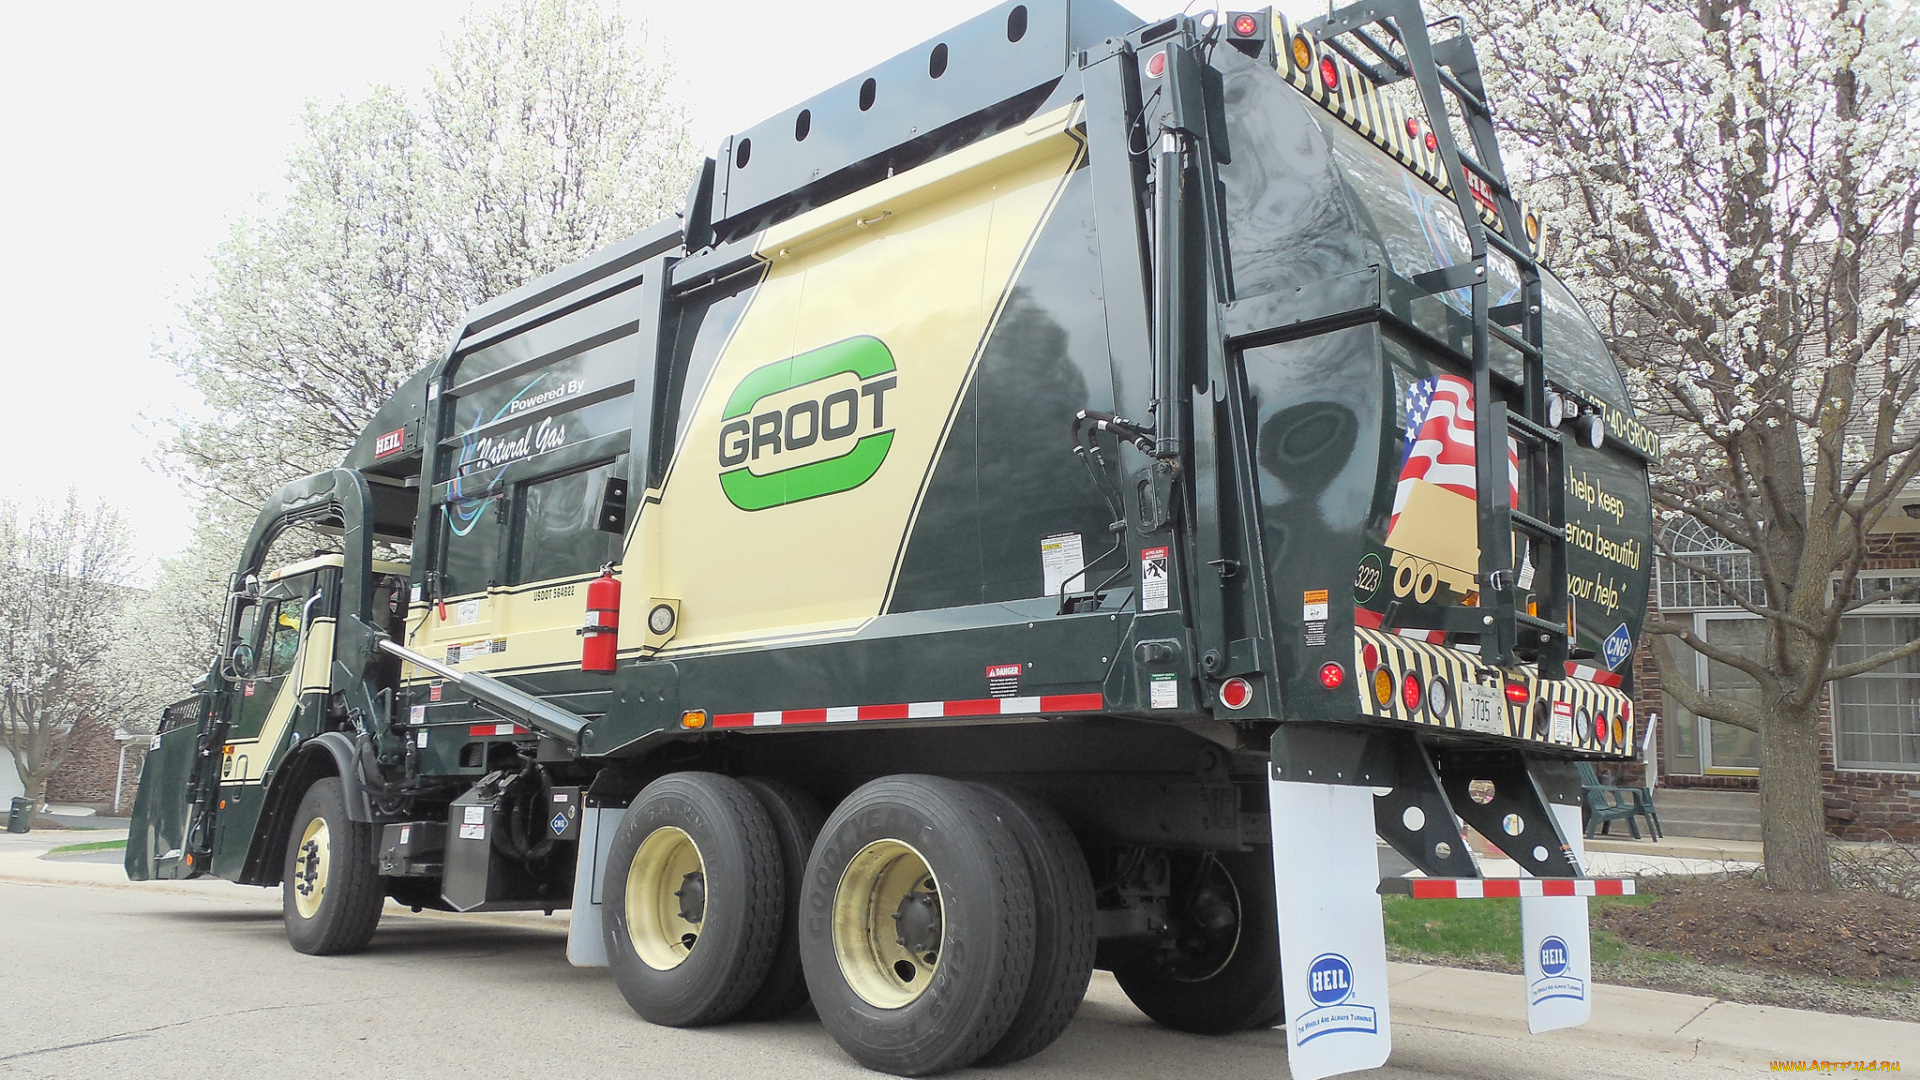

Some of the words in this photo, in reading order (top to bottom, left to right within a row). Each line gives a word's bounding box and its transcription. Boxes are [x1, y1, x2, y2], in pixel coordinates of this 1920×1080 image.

[510, 384, 565, 413] Powered
[567, 380, 585, 394] By
[719, 375, 897, 468] GROOT
[375, 433, 401, 455] HEIL
[476, 425, 533, 469] Natural
[532, 416, 566, 457] Gas
[1569, 465, 1596, 511] help
[1597, 479, 1625, 525] keep
[1565, 519, 1593, 551] erica
[1595, 524, 1641, 571] beautiful
[1354, 565, 1380, 592] 3223
[1567, 573, 1594, 600] your
[533, 589, 552, 601] USDOT
[1606, 636, 1629, 657] CNG
[1470, 698, 1490, 722] 3735
[1541, 949, 1566, 966] HEIL
[1312, 969, 1349, 992] HEIL
